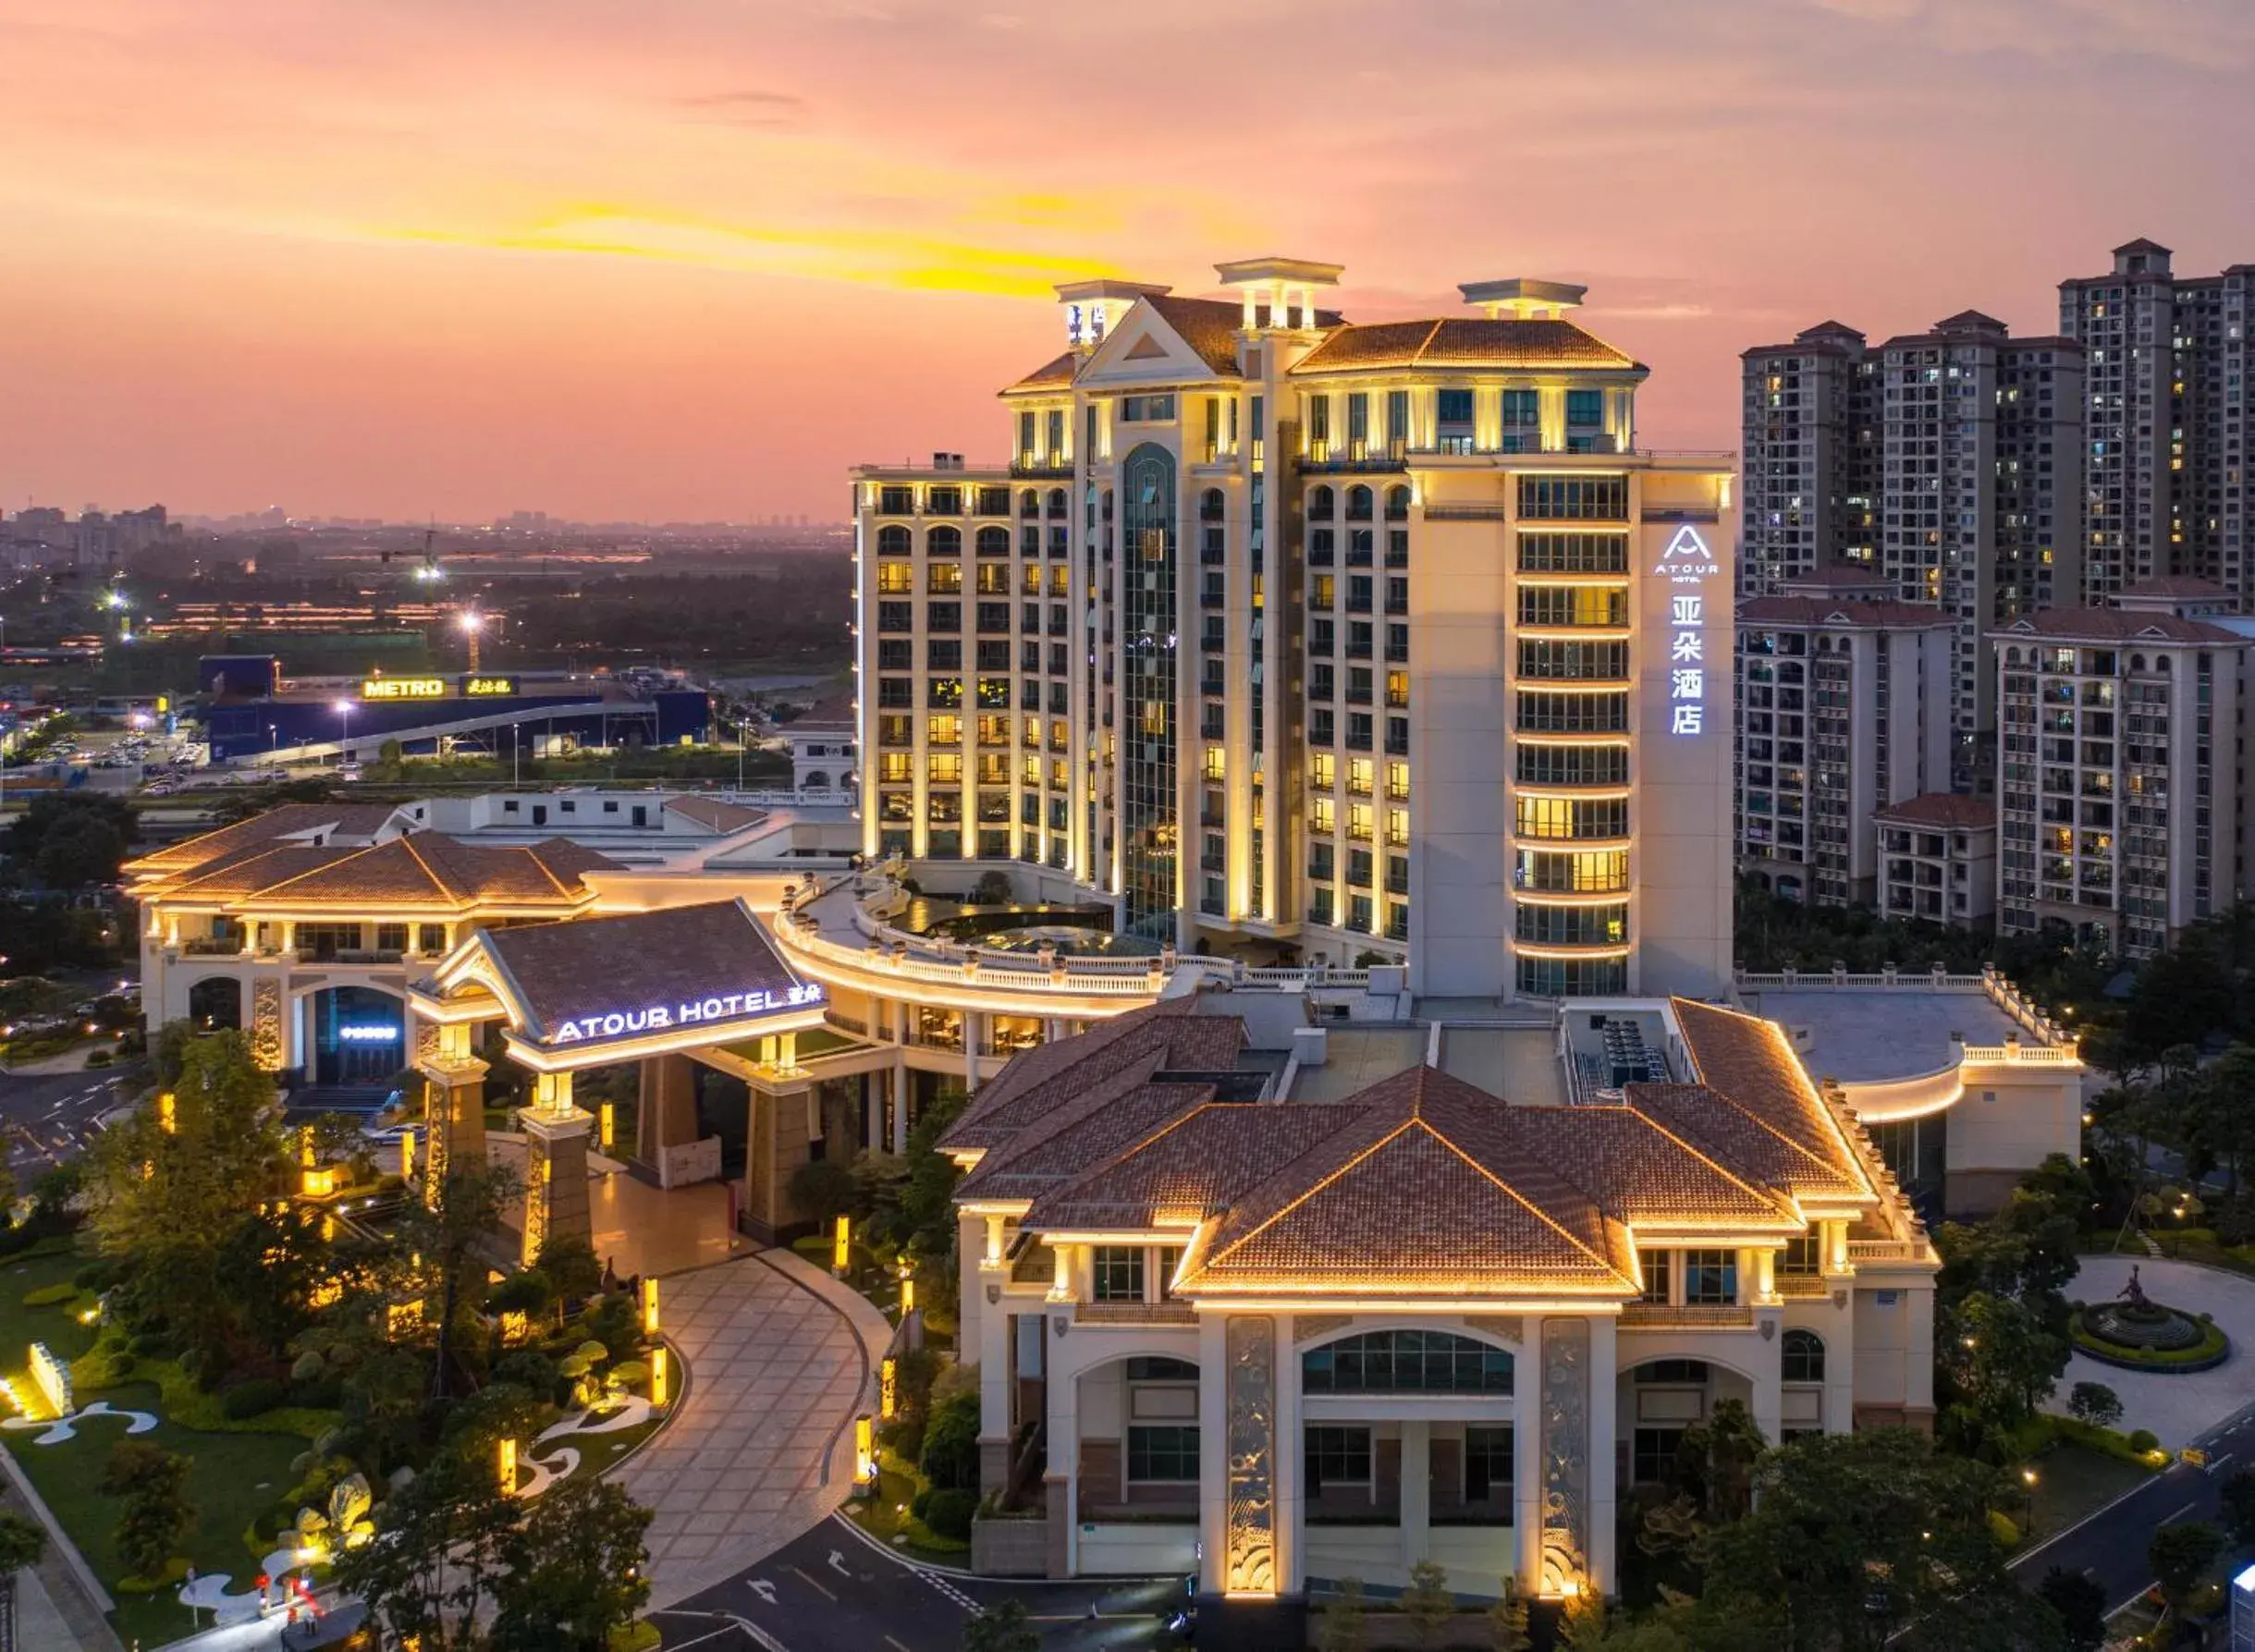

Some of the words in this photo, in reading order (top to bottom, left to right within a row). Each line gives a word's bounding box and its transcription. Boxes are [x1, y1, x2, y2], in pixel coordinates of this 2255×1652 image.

[1654, 564, 1719, 574] ATOUR
[1672, 595, 1703, 735] 亚朵酒店
[364, 679, 444, 697] METRO
[555, 1007, 670, 1043] ATOUR
[680, 989, 783, 1022] HOTEL
